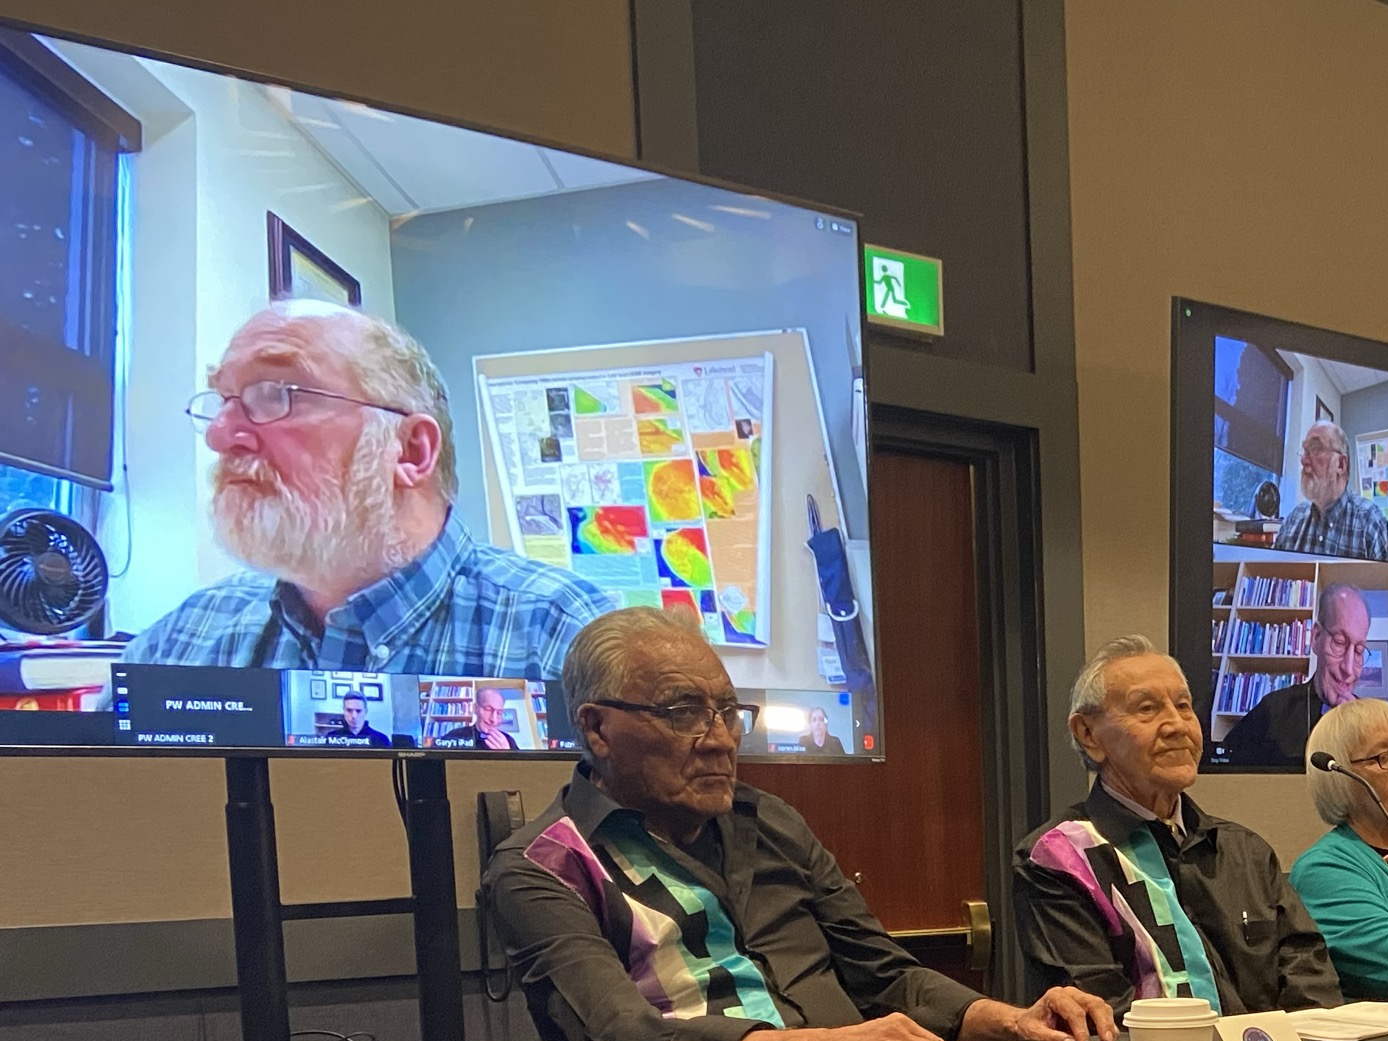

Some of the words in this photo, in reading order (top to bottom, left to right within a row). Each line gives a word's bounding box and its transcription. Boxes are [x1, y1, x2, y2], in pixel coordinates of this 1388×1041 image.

[165, 700, 183, 710] PW
[186, 700, 222, 711] ADMIN
[138, 734, 152, 742] PW
[154, 734, 184, 742] ADMIN
[185, 734, 207, 743] CREE
[207, 735, 214, 743] 2
